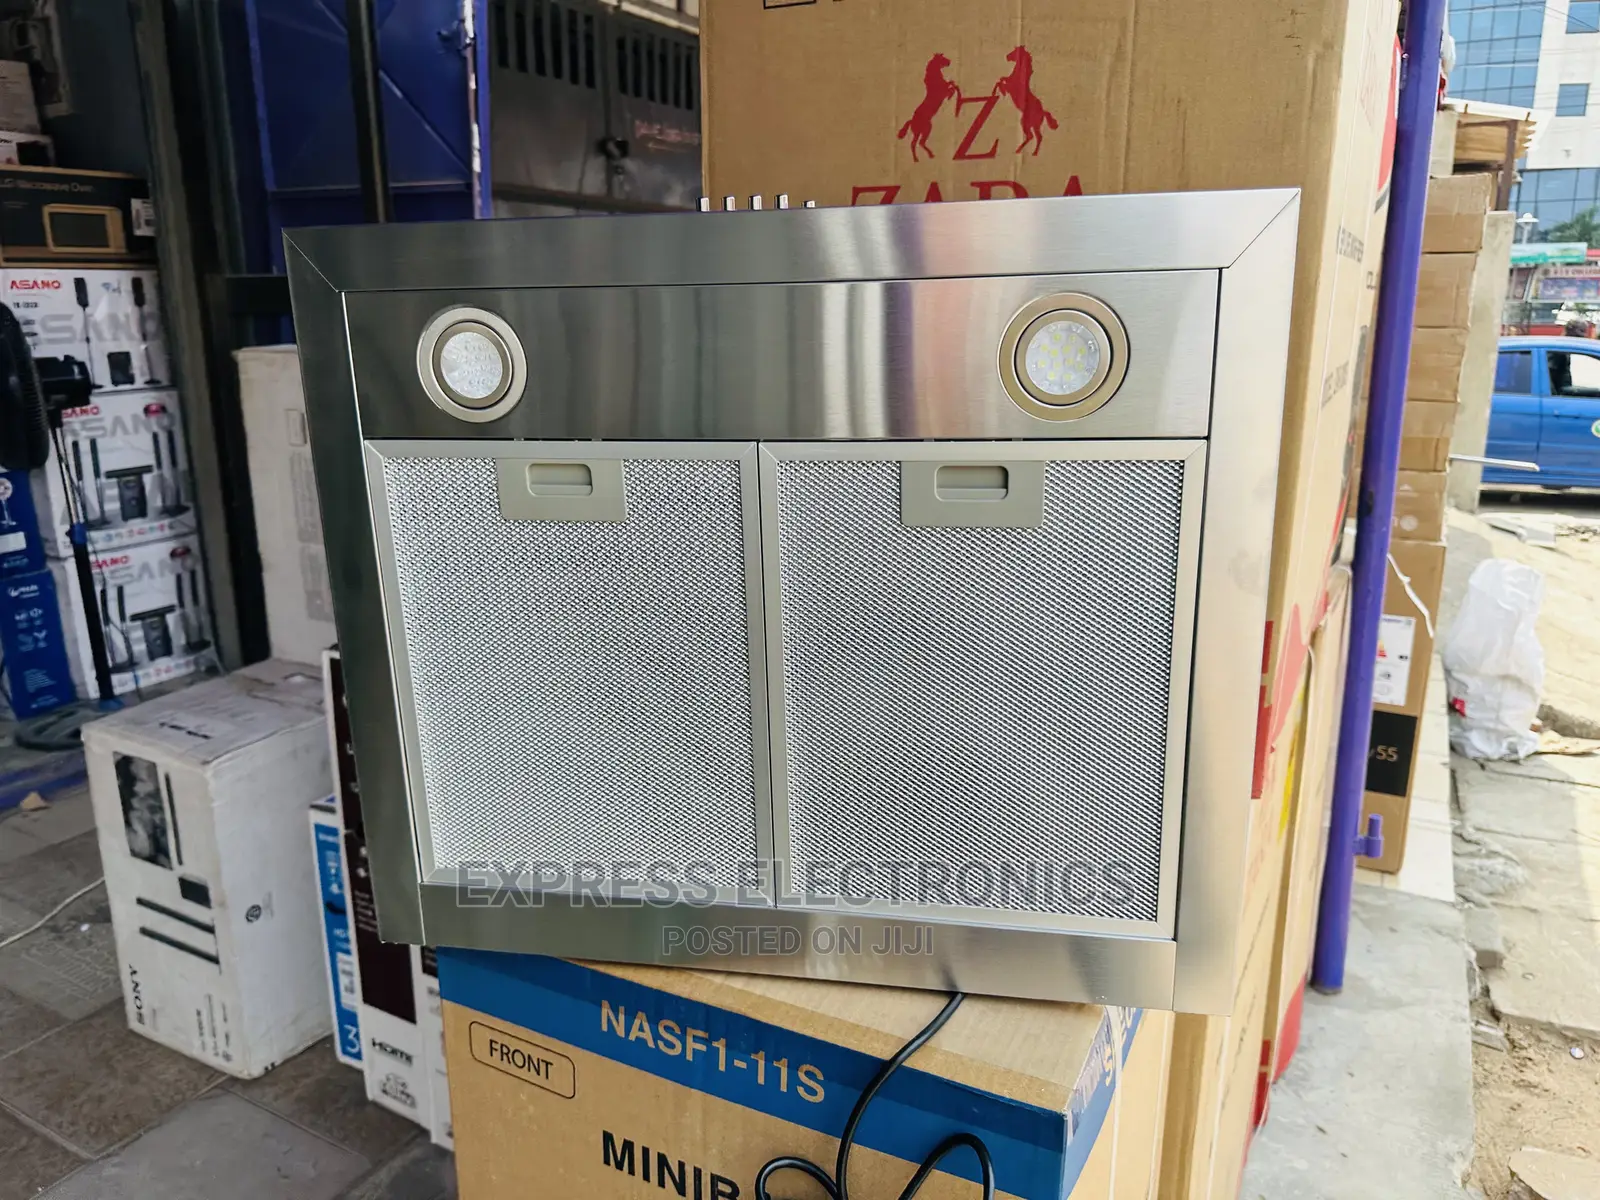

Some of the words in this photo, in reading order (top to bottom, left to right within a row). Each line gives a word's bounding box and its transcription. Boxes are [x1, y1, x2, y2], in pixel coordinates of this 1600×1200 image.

[10, 280, 61, 290] ASANO
[62, 405, 100, 418] SANO
[91, 556, 129, 571] SANO
[128, 963, 145, 1026] SONY
[489, 1038, 554, 1081] FRONT
[601, 999, 825, 1103] NASF1-11S
